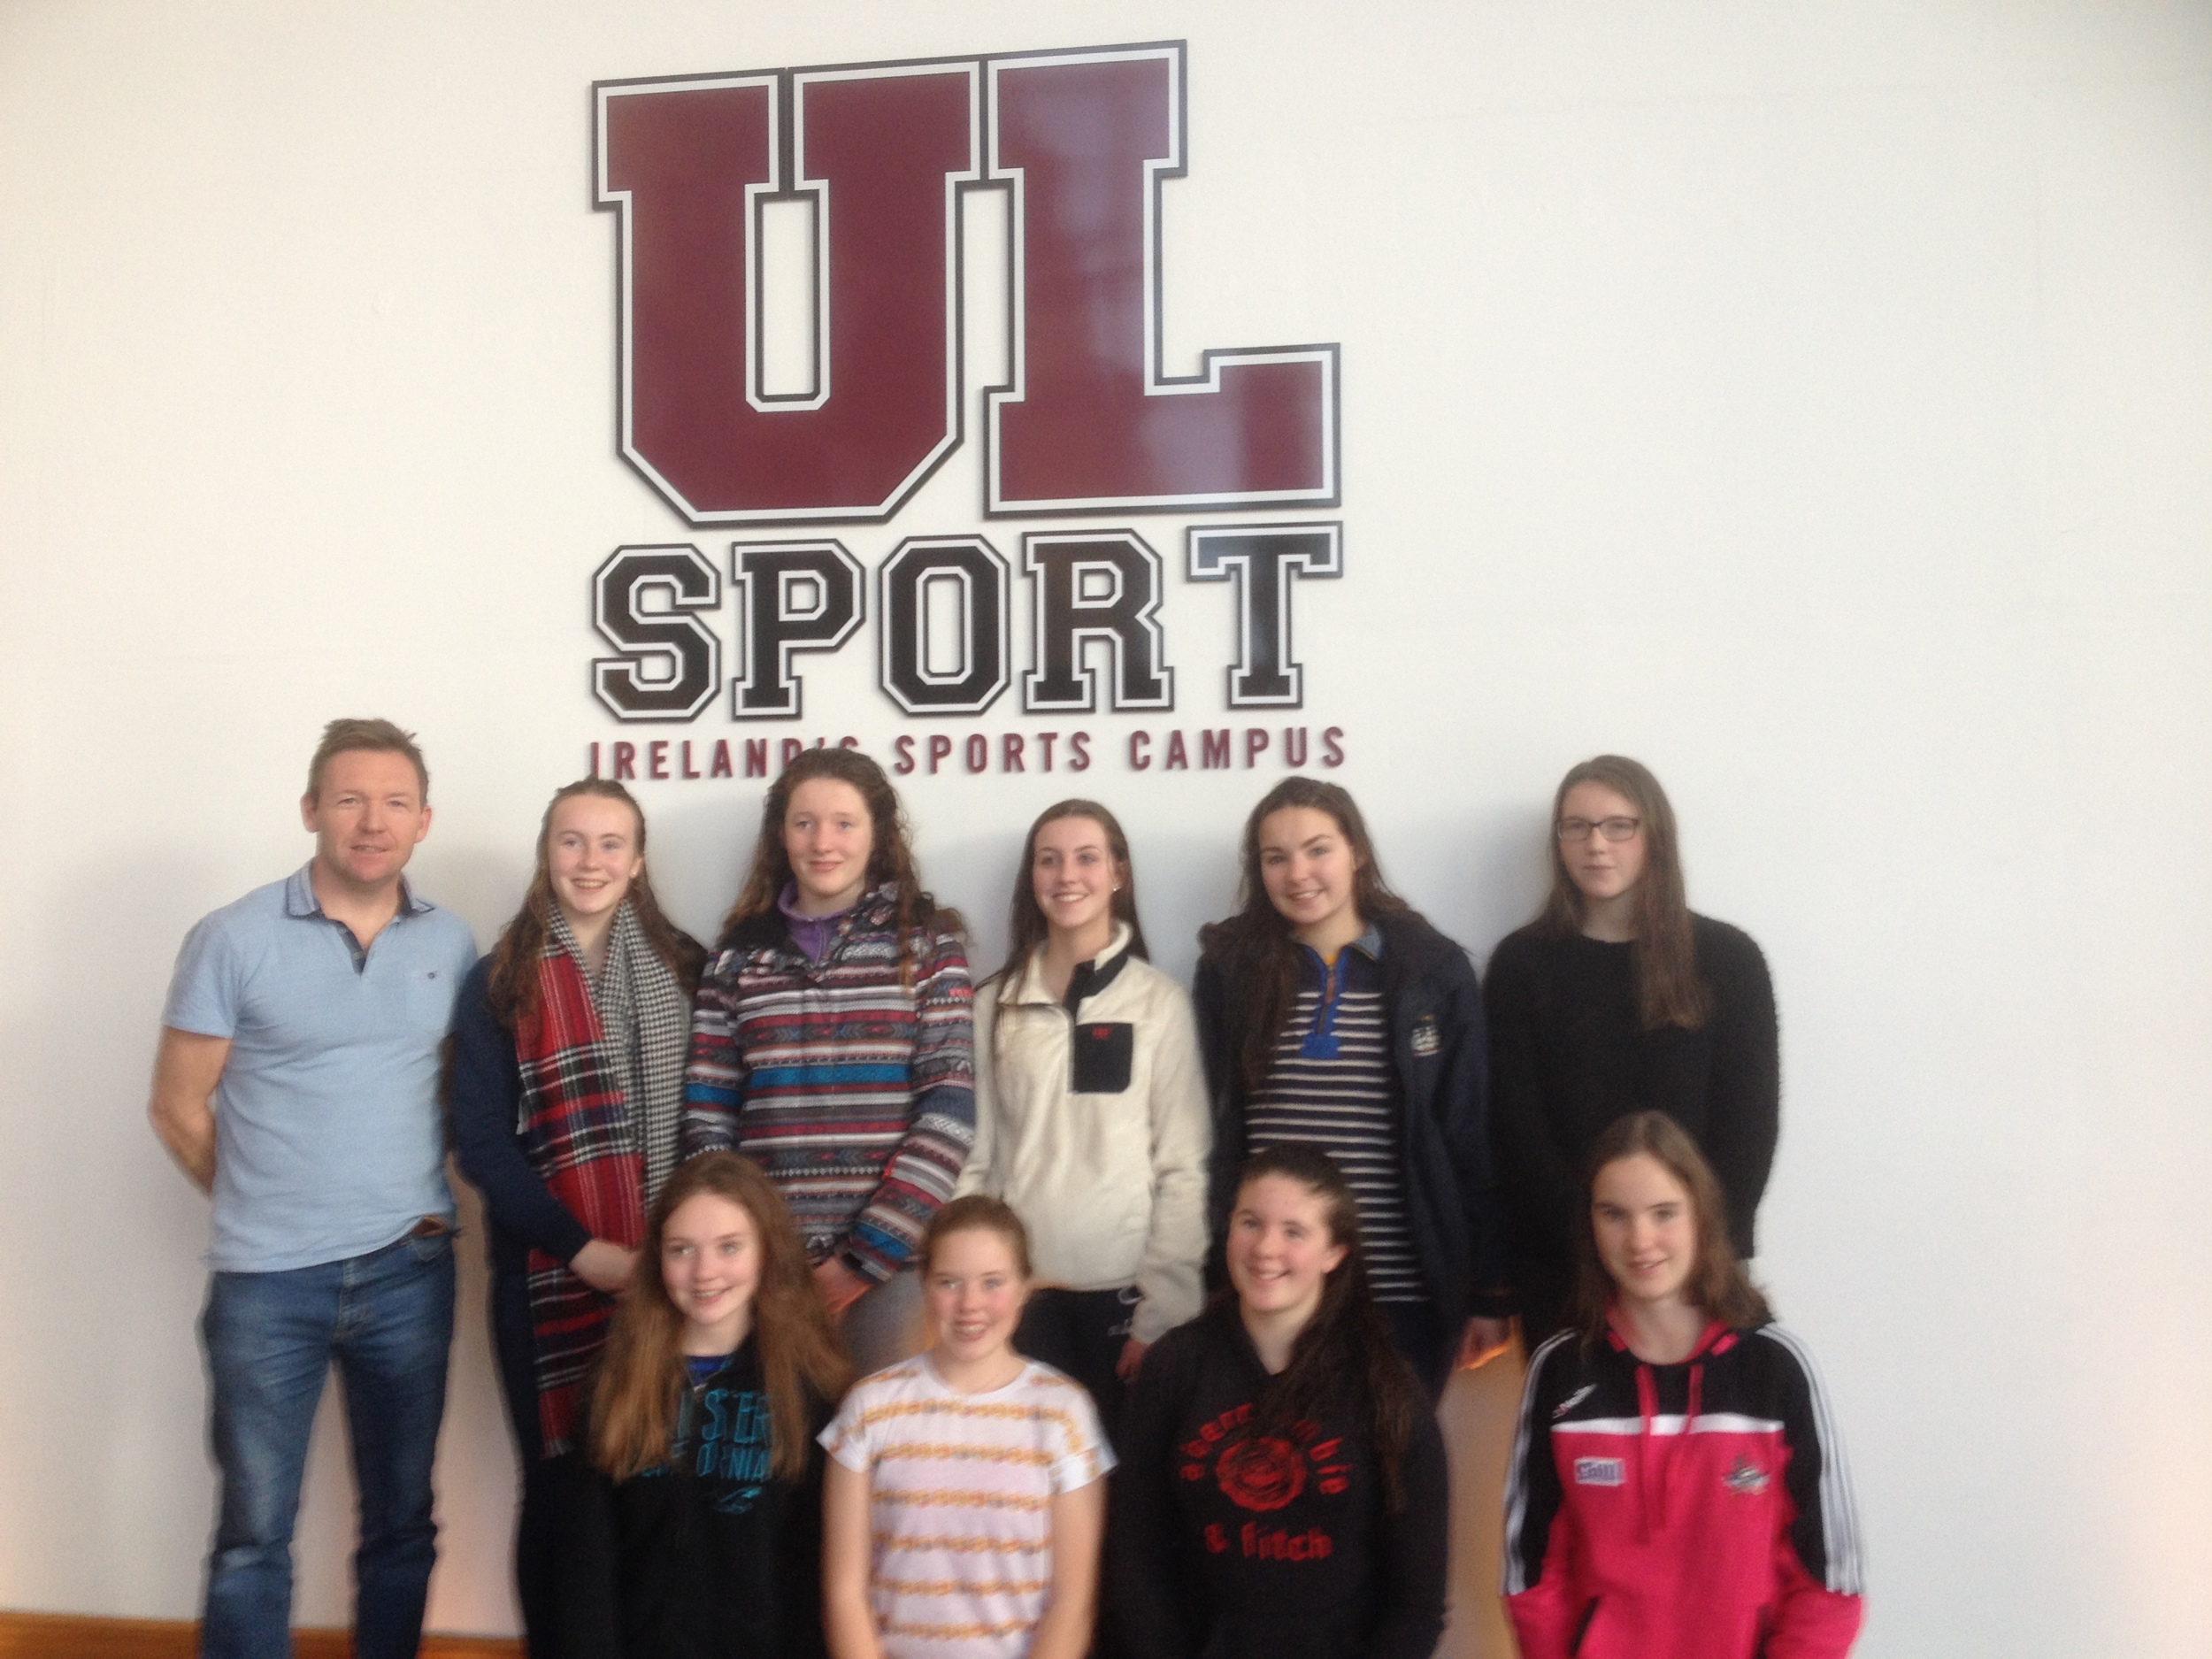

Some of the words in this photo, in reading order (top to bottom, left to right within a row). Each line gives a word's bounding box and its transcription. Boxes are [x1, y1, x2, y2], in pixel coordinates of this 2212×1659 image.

[592, 39, 1341, 528] UL
[591, 520, 1343, 723] SPORT
[894, 731, 1092, 775] SPORTS
[1129, 726, 1345, 771] CAMPUS
